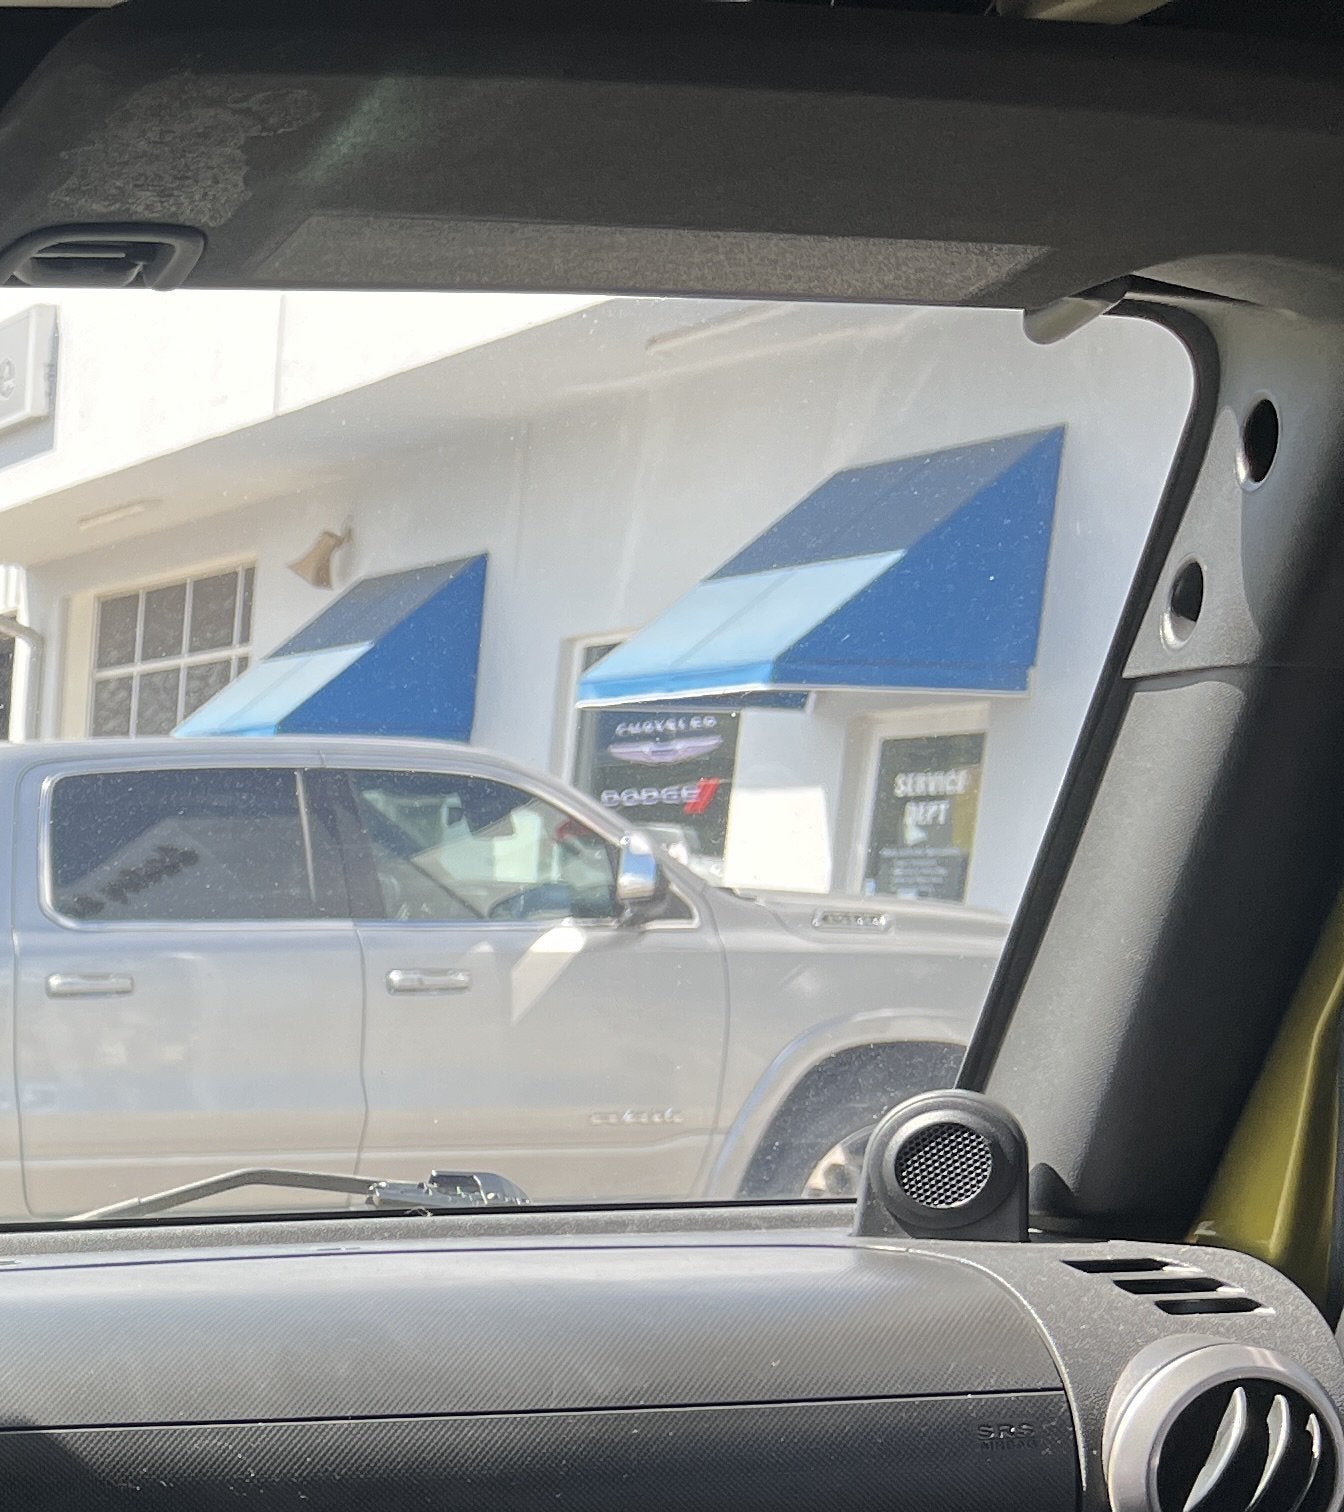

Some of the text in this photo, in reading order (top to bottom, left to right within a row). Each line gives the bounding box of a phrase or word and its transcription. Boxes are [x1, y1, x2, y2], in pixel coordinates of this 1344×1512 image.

[600, 784, 700, 807] DODGE
[894, 769, 968, 798] SERVICE
[904, 800, 949, 826] DEPT
